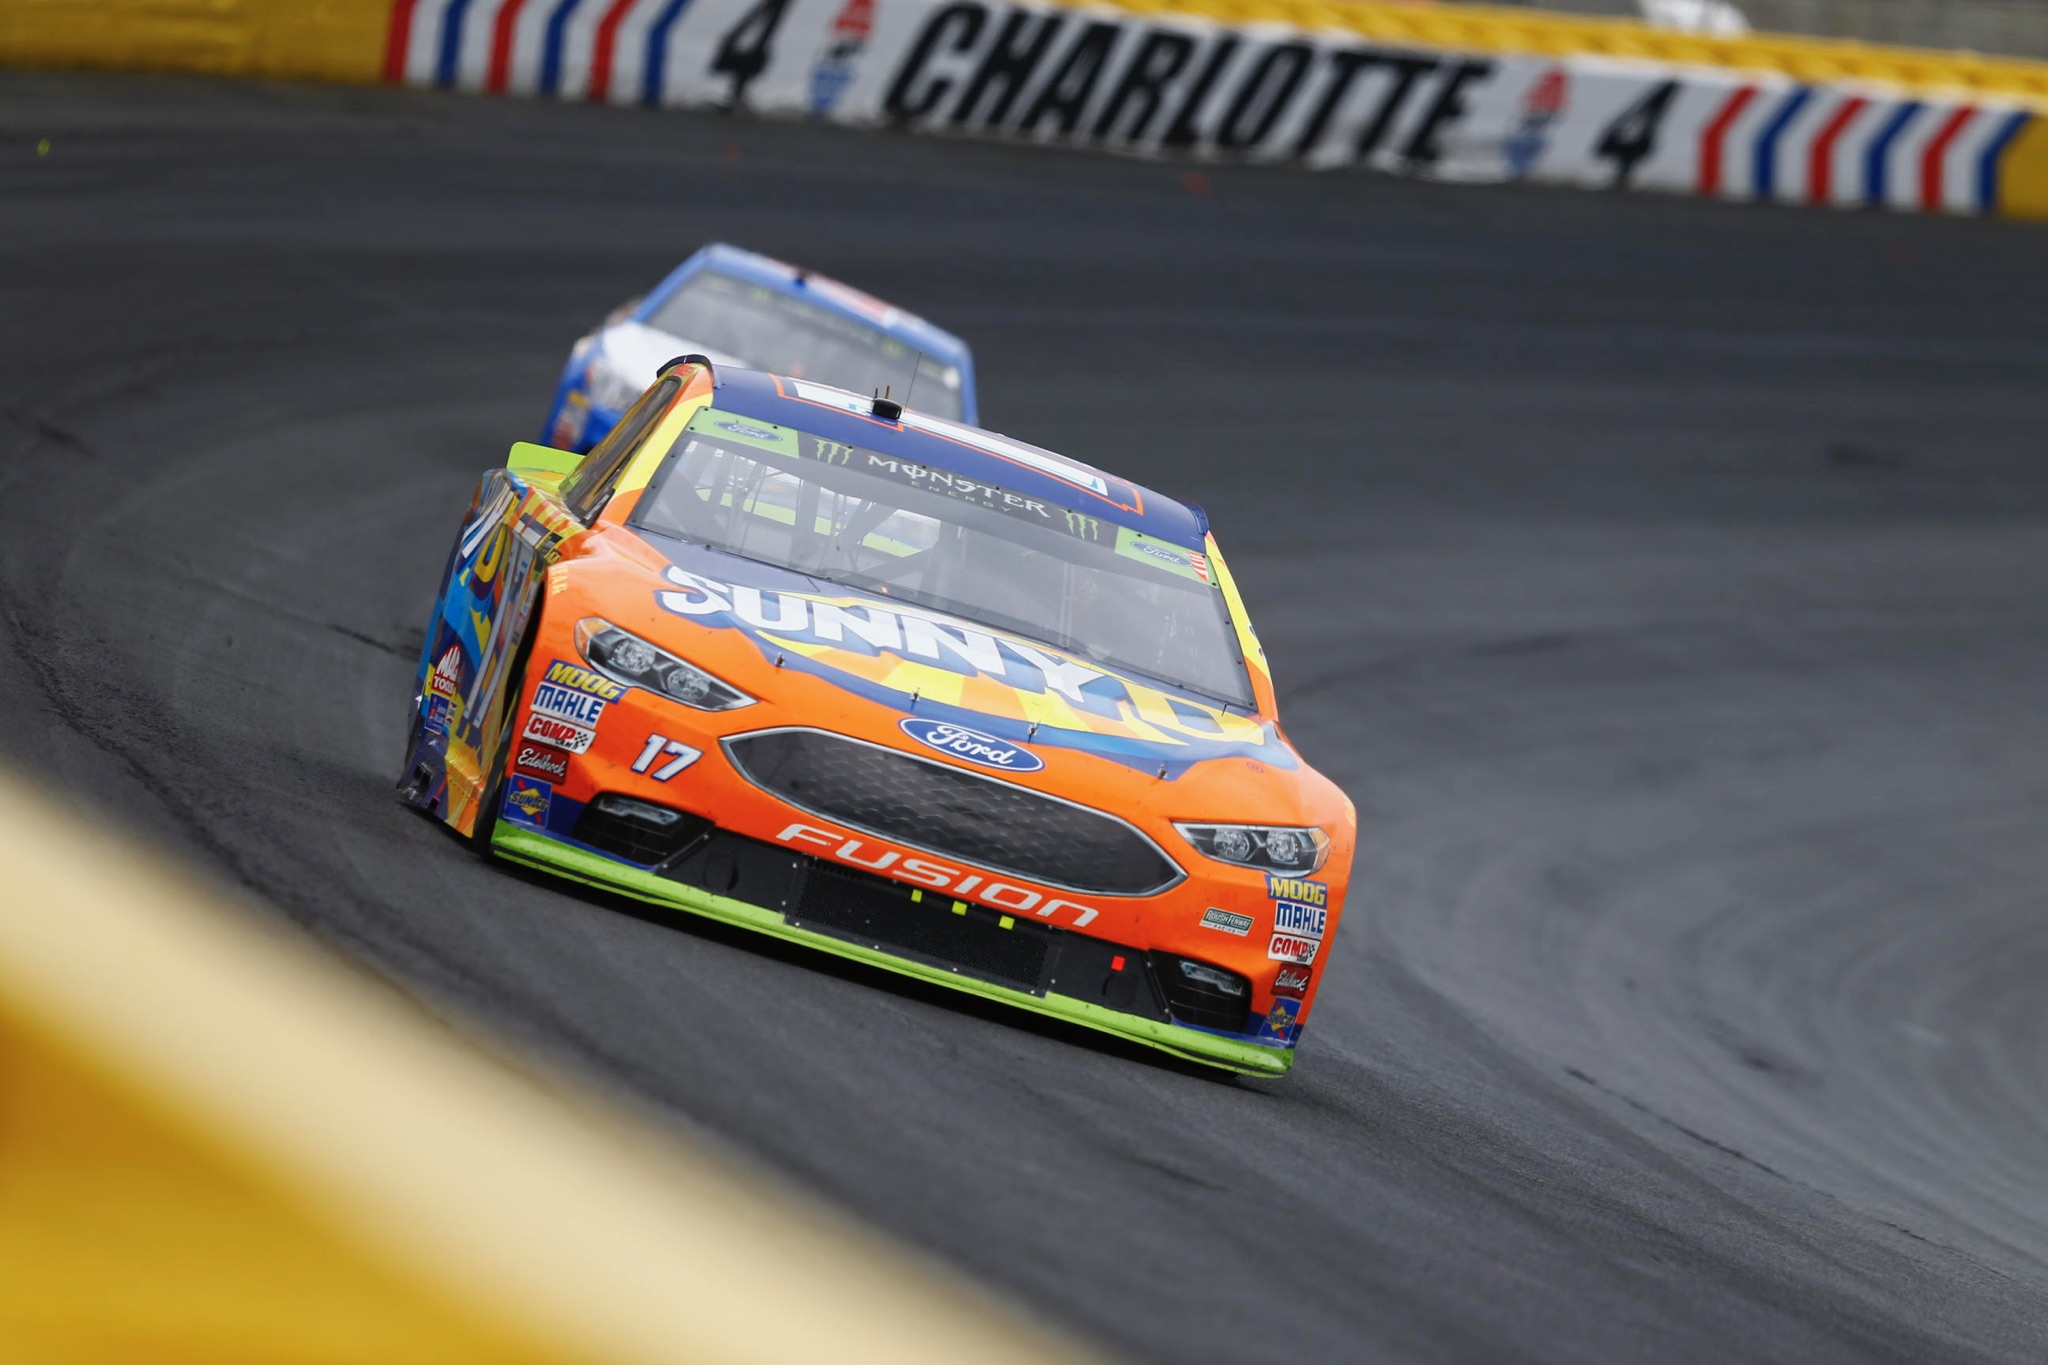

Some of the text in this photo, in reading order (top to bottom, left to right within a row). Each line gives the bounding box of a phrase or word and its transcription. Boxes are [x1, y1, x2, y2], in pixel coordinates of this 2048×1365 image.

[707, 0, 1680, 190] 4 CHARLOTTE 4
[727, 424, 771, 440] Ford
[911, 480, 1011, 512] ENERGY
[1143, 543, 1181, 564] Ford
[545, 663, 627, 700] MOOG
[533, 684, 603, 723] MAHLE
[528, 718, 577, 741] COMP
[926, 724, 1017, 765] Ford
[630, 732, 705, 783] 17
[775, 823, 1099, 928] FUSION
[1270, 877, 1326, 905] MOOG
[1275, 902, 1326, 934] MAHLE
[1271, 937, 1309, 957] COMP
